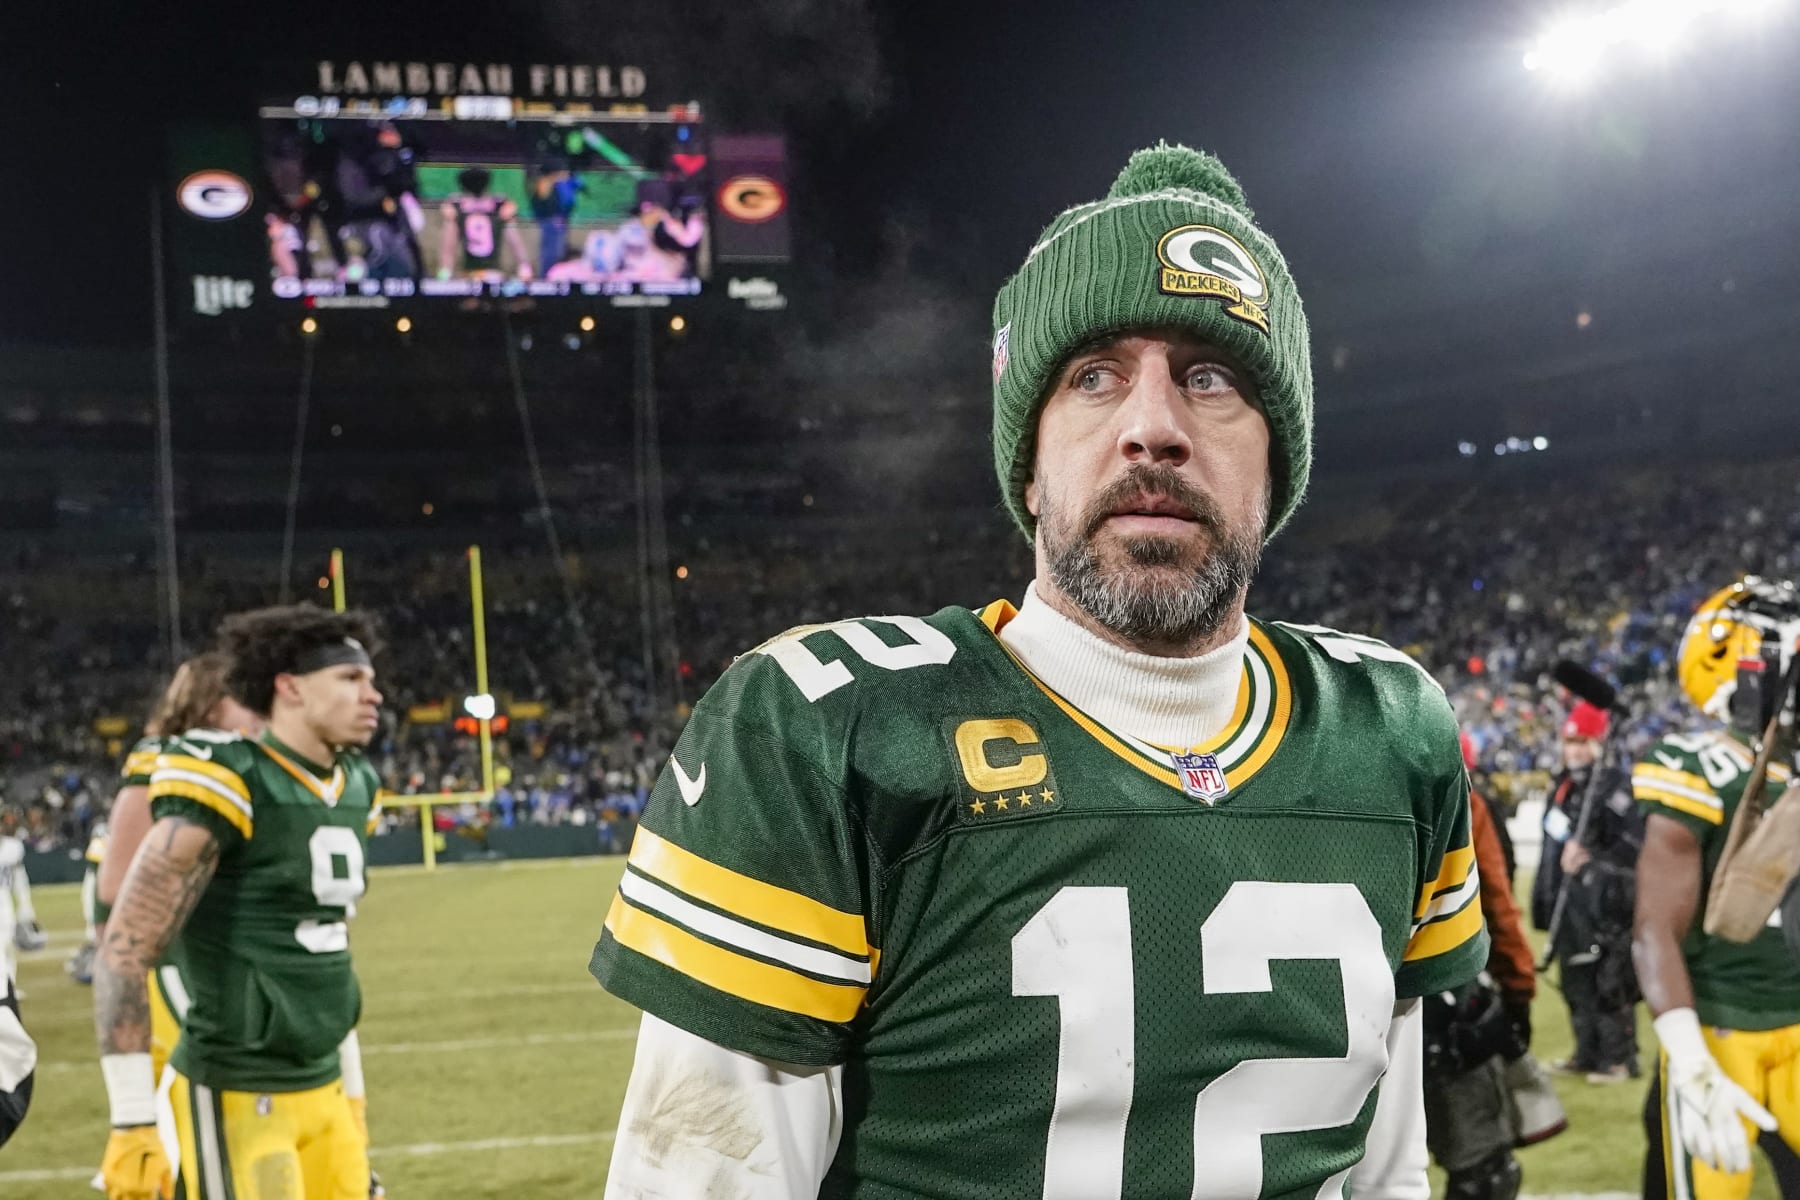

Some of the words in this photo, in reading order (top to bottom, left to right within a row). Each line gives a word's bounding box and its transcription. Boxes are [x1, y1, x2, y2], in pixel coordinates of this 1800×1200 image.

[318, 61, 512, 94] LAMBEAU
[530, 65, 646, 97] FIELD
[465, 212, 494, 257] 9
[1165, 272, 1237, 296] PACKERS
[955, 718, 1048, 793] C
[1186, 769, 1222, 792] NFL
[295, 825, 365, 954] 9
[1011, 881, 1396, 1200] 12
